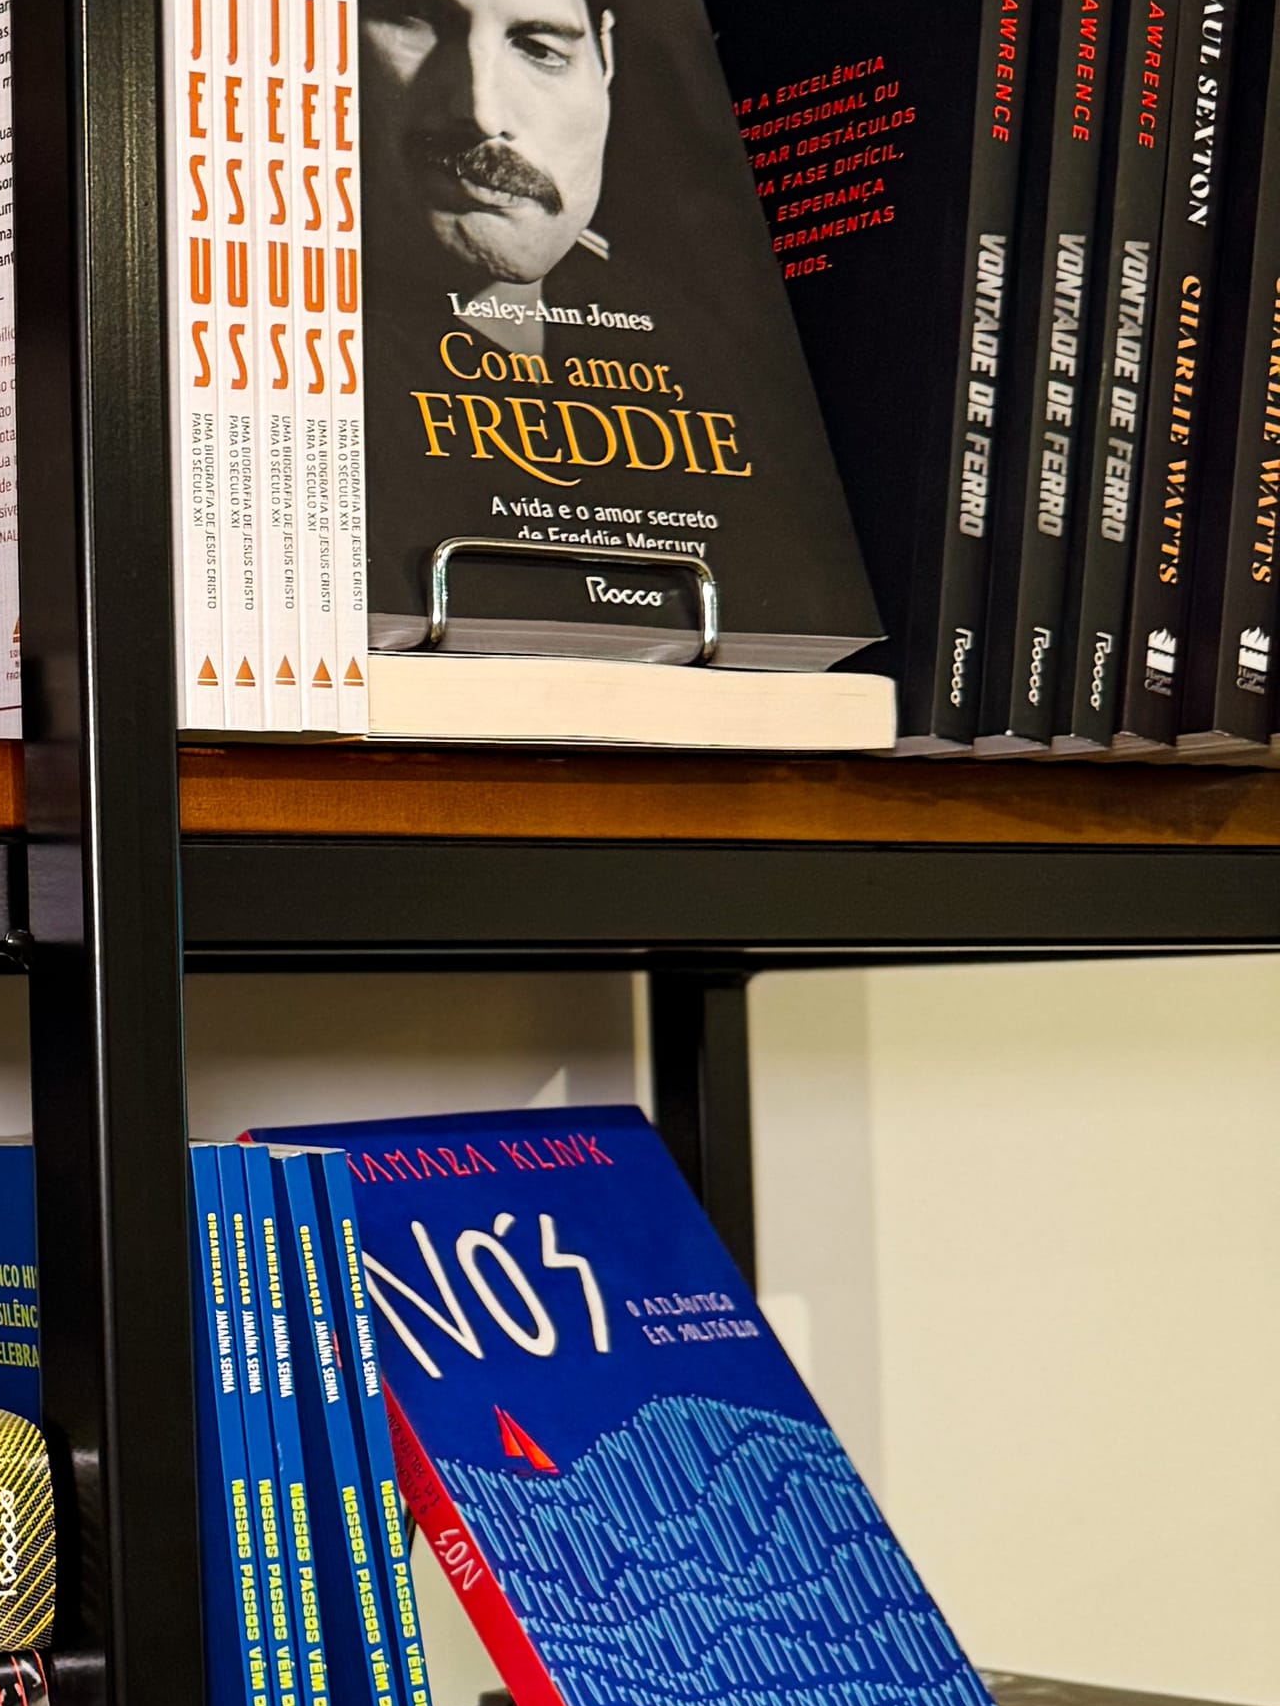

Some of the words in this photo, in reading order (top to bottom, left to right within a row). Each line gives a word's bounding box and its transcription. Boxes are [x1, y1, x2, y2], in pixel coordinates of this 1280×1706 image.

[796, 106, 917, 157] OBSTÁCULOS
[1188, 75, 1217, 225] SEXTON
[781, 163, 828, 191] FASE
[833, 144, 905, 177] DIFÍCIL,
[776, 178, 885, 222] ESPERANÇA
[448, 293, 583, 326] Lesley-Ann
[587, 303, 655, 331] Jones
[970, 234, 1004, 376] VONTADE
[439, 331, 553, 385] Com
[564, 355, 684, 402] amor,
[1170, 275, 1201, 444] CHARLIE
[967, 381, 993, 426] DE
[410, 390, 754, 488] FREDDIE
[959, 432, 989, 536] FERRO
[492, 496, 507, 516] A
[510, 498, 554, 519] vida
[559, 506, 572, 520] e
[576, 507, 589, 521] o
[595, 508, 642, 524] amor
[647, 510, 719, 529] secreto
[1159, 460, 1186, 583] WATTS
[586, 576, 663, 607] Rocco
[500, 1133, 613, 1170] KLINK
[263, 1217, 281, 1308] ORGANIZAÇÃO
[626, 1300, 641, 1317] O
[272, 1314, 289, 1359] JANAÍNA
[277, 1361, 292, 1397] SENNA
[289, 1482, 310, 1561] NOSSOS
[298, 1566, 319, 1642] PASSOS
[308, 1648, 325, 1691] VÊM
